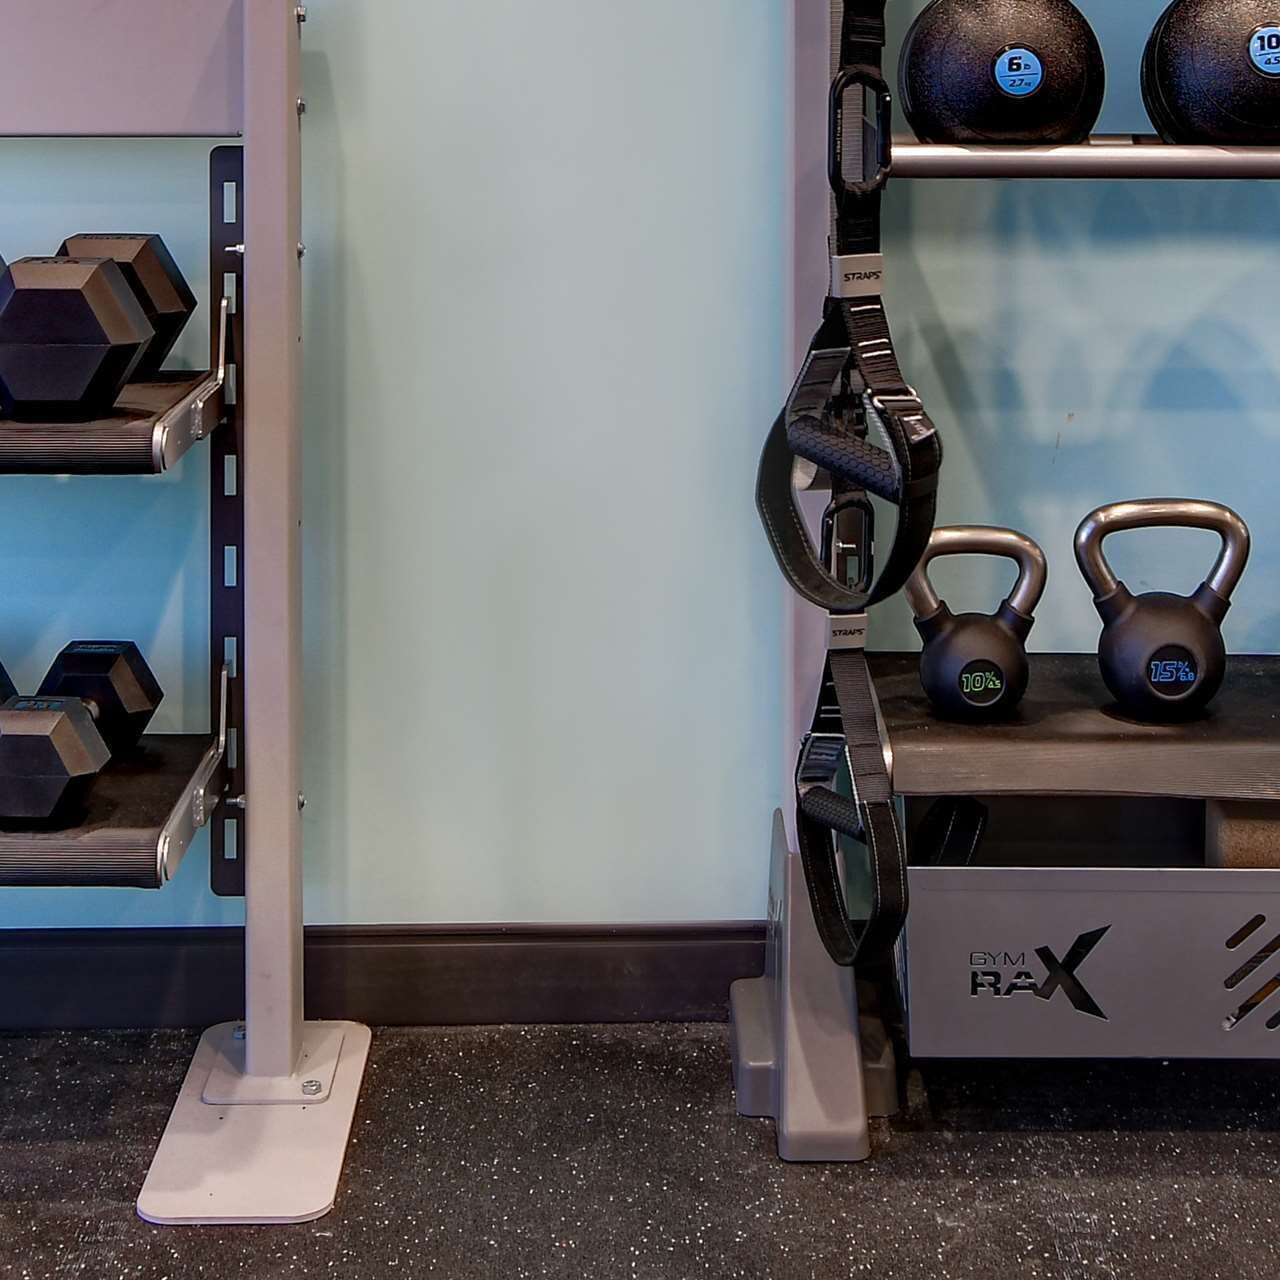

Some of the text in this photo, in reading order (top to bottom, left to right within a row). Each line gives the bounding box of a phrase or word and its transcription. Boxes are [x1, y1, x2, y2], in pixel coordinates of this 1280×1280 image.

[1257, 33, 1280, 51] 10
[1007, 56, 1022, 73] 6
[843, 270, 882, 282] STRAPS
[1151, 660, 1177, 682] 15
[962, 672, 985, 692] 10
[970, 951, 1025, 967] GYM
[970, 924, 1113, 1022] RAX
